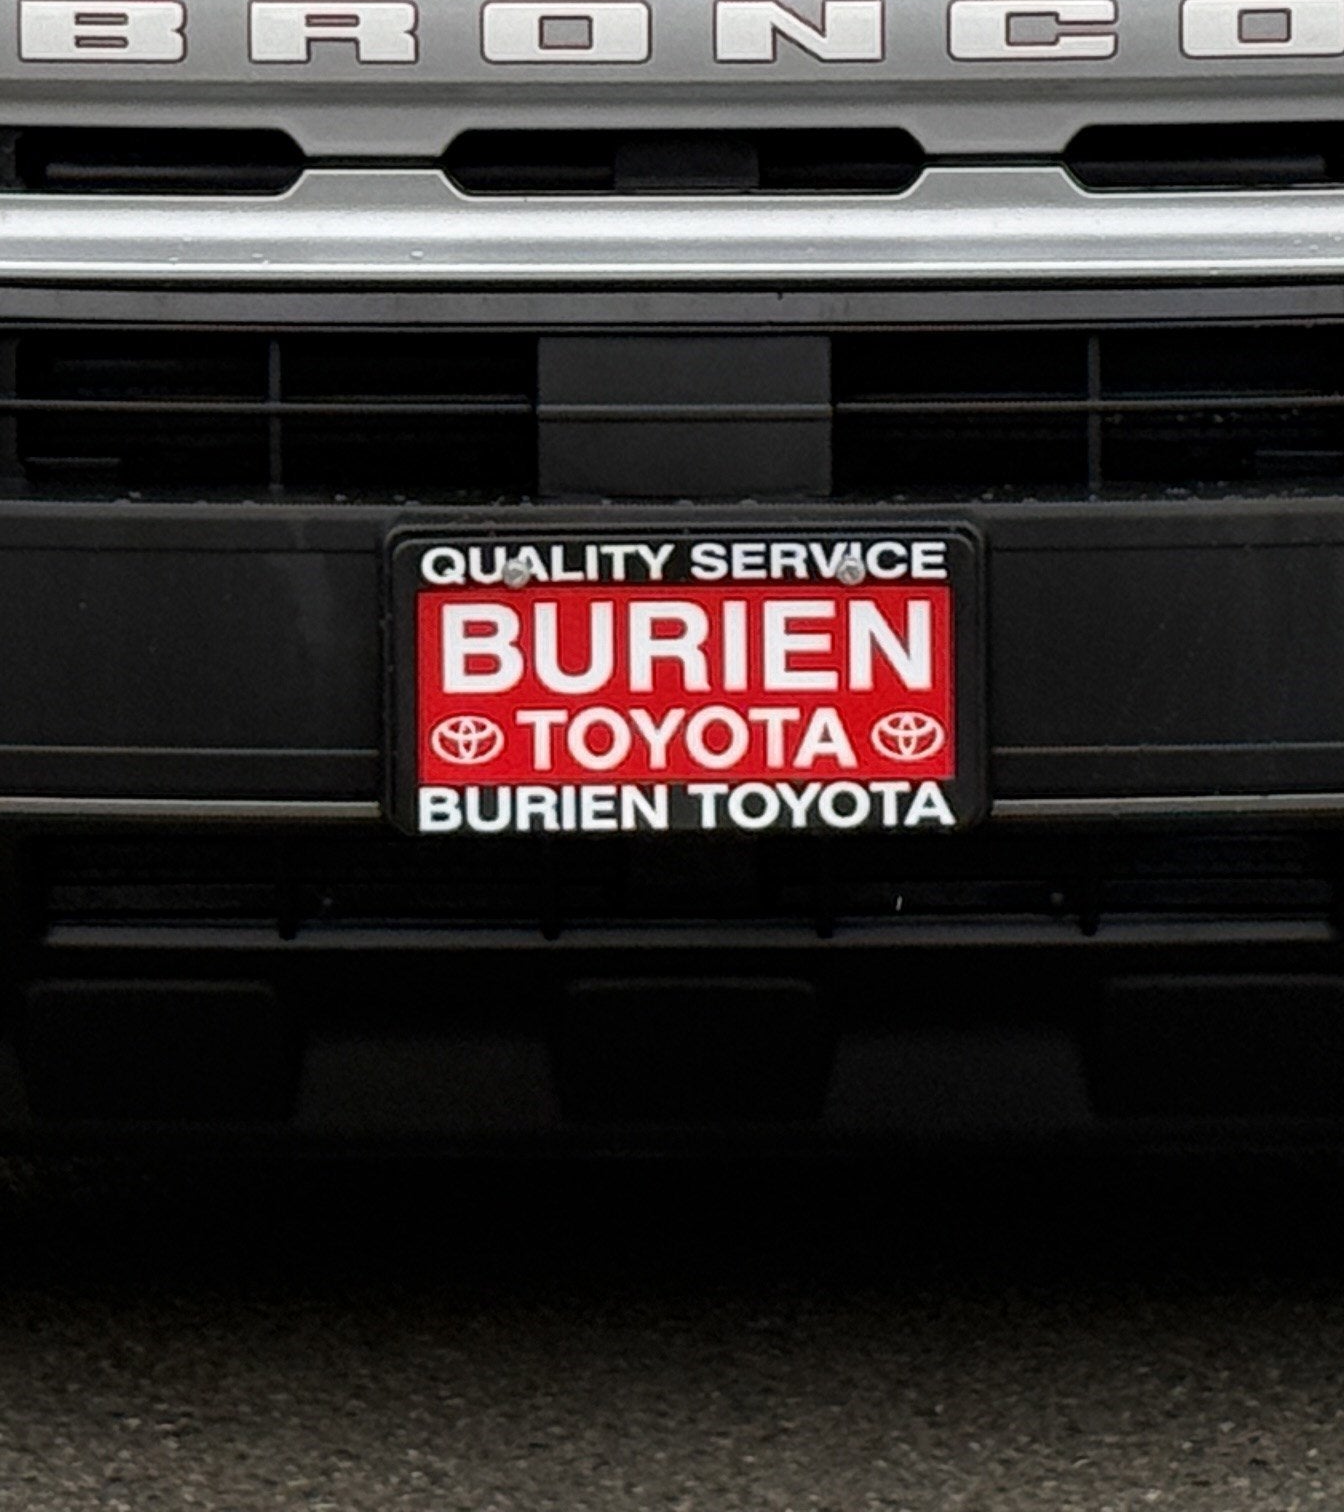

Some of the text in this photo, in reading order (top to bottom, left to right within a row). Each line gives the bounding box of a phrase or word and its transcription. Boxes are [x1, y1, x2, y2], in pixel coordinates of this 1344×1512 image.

[421, 544, 674, 585] QUALITY
[441, 599, 934, 694] BURIEN
[516, 705, 859, 771] TOYOTA
[418, 782, 955, 833] BURIEN TOYOTA
